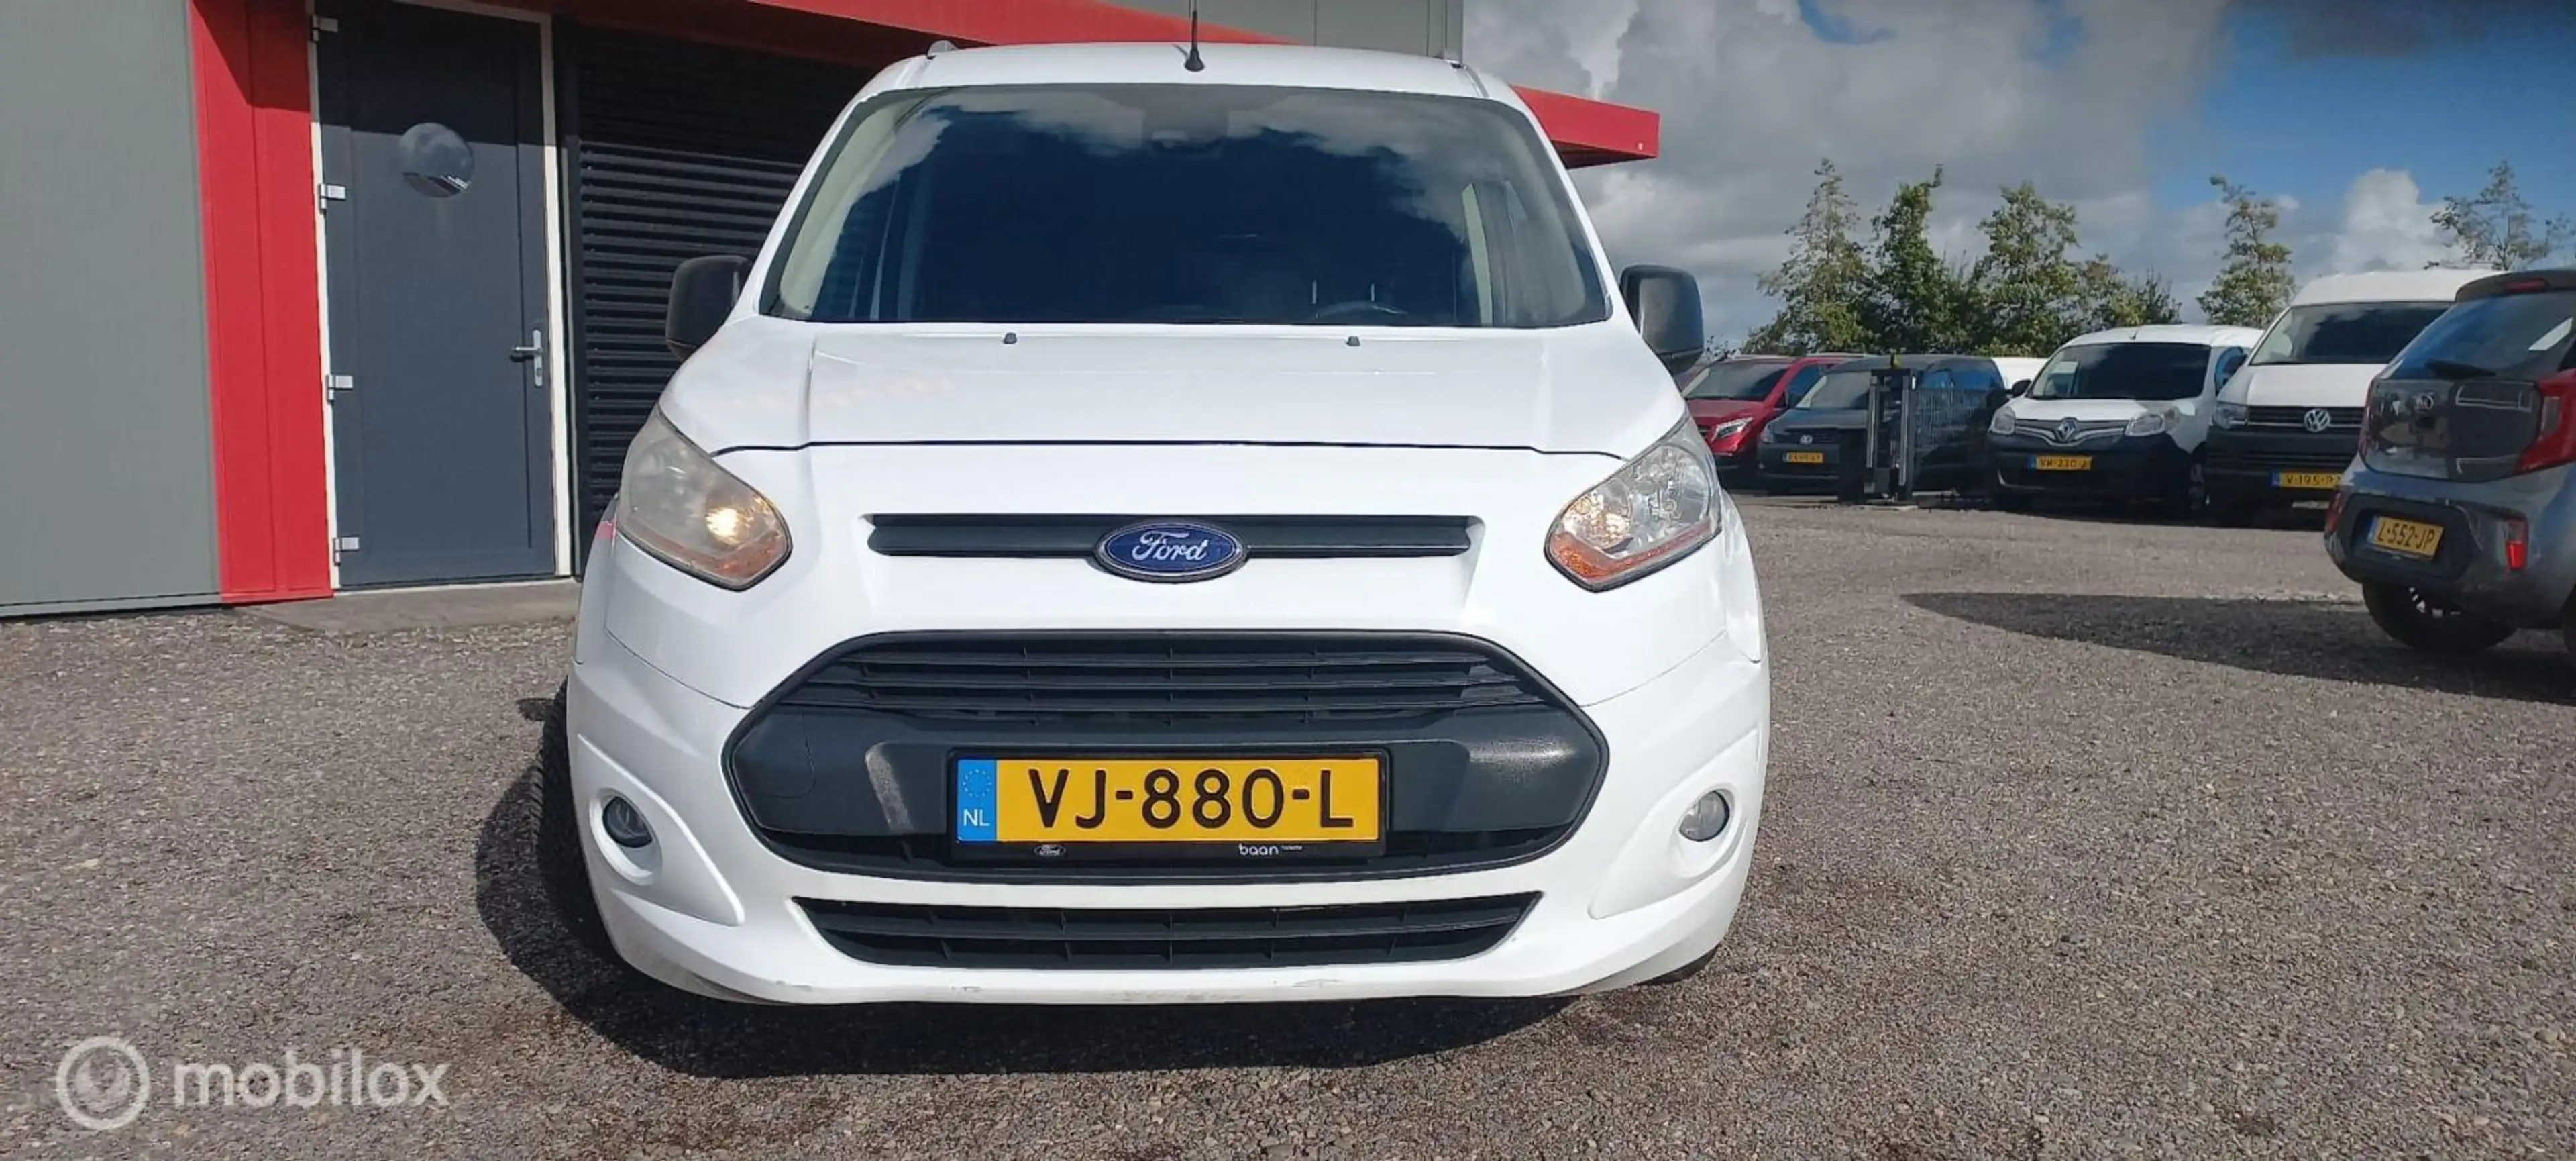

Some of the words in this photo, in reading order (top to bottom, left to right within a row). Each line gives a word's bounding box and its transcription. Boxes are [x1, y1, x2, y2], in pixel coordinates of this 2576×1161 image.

[1131, 530, 1209, 561] Ford
[2377, 521, 2435, 550] L-552-JP
[963, 808, 991, 827] NL
[1028, 768, 1354, 829] VJ-880-L
[1238, 843, 1279, 856] baan
